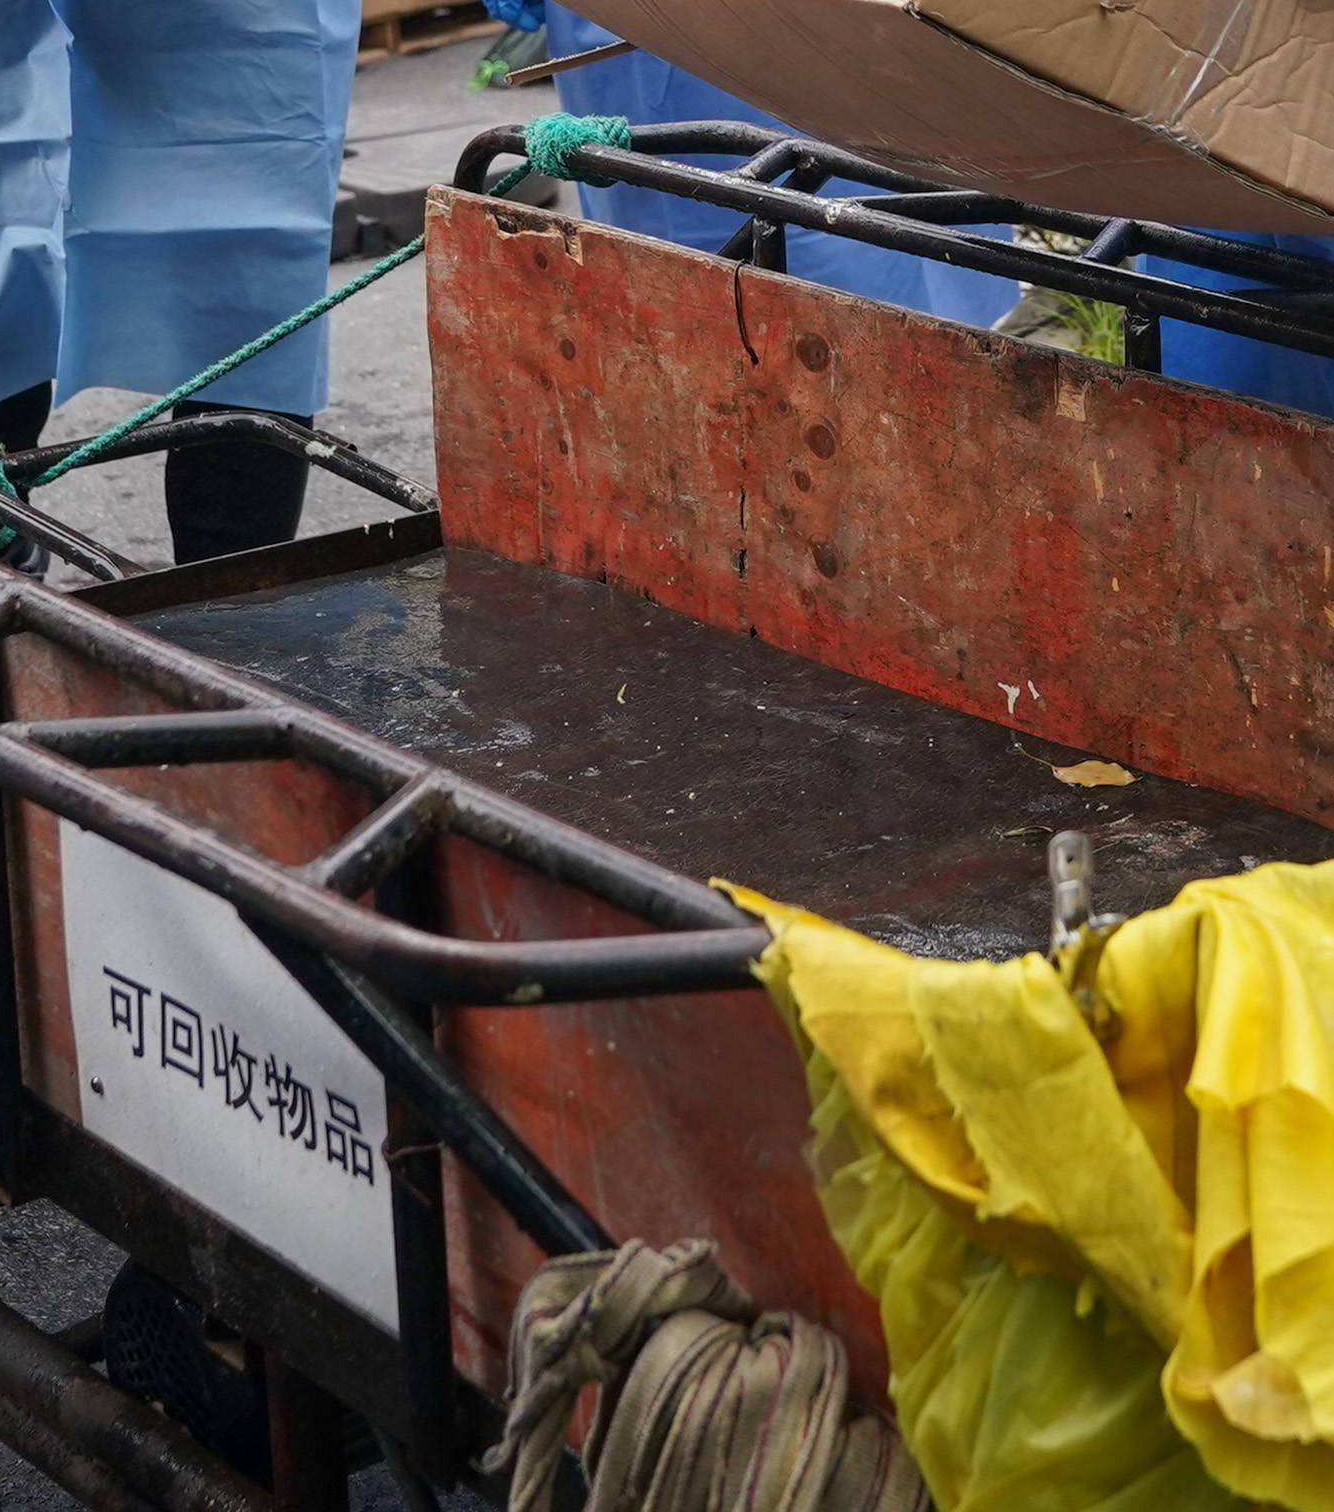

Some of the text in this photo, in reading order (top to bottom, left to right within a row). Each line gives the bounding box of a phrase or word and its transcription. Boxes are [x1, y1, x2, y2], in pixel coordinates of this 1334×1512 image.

[103, 965, 375, 1187] 可回收物品
